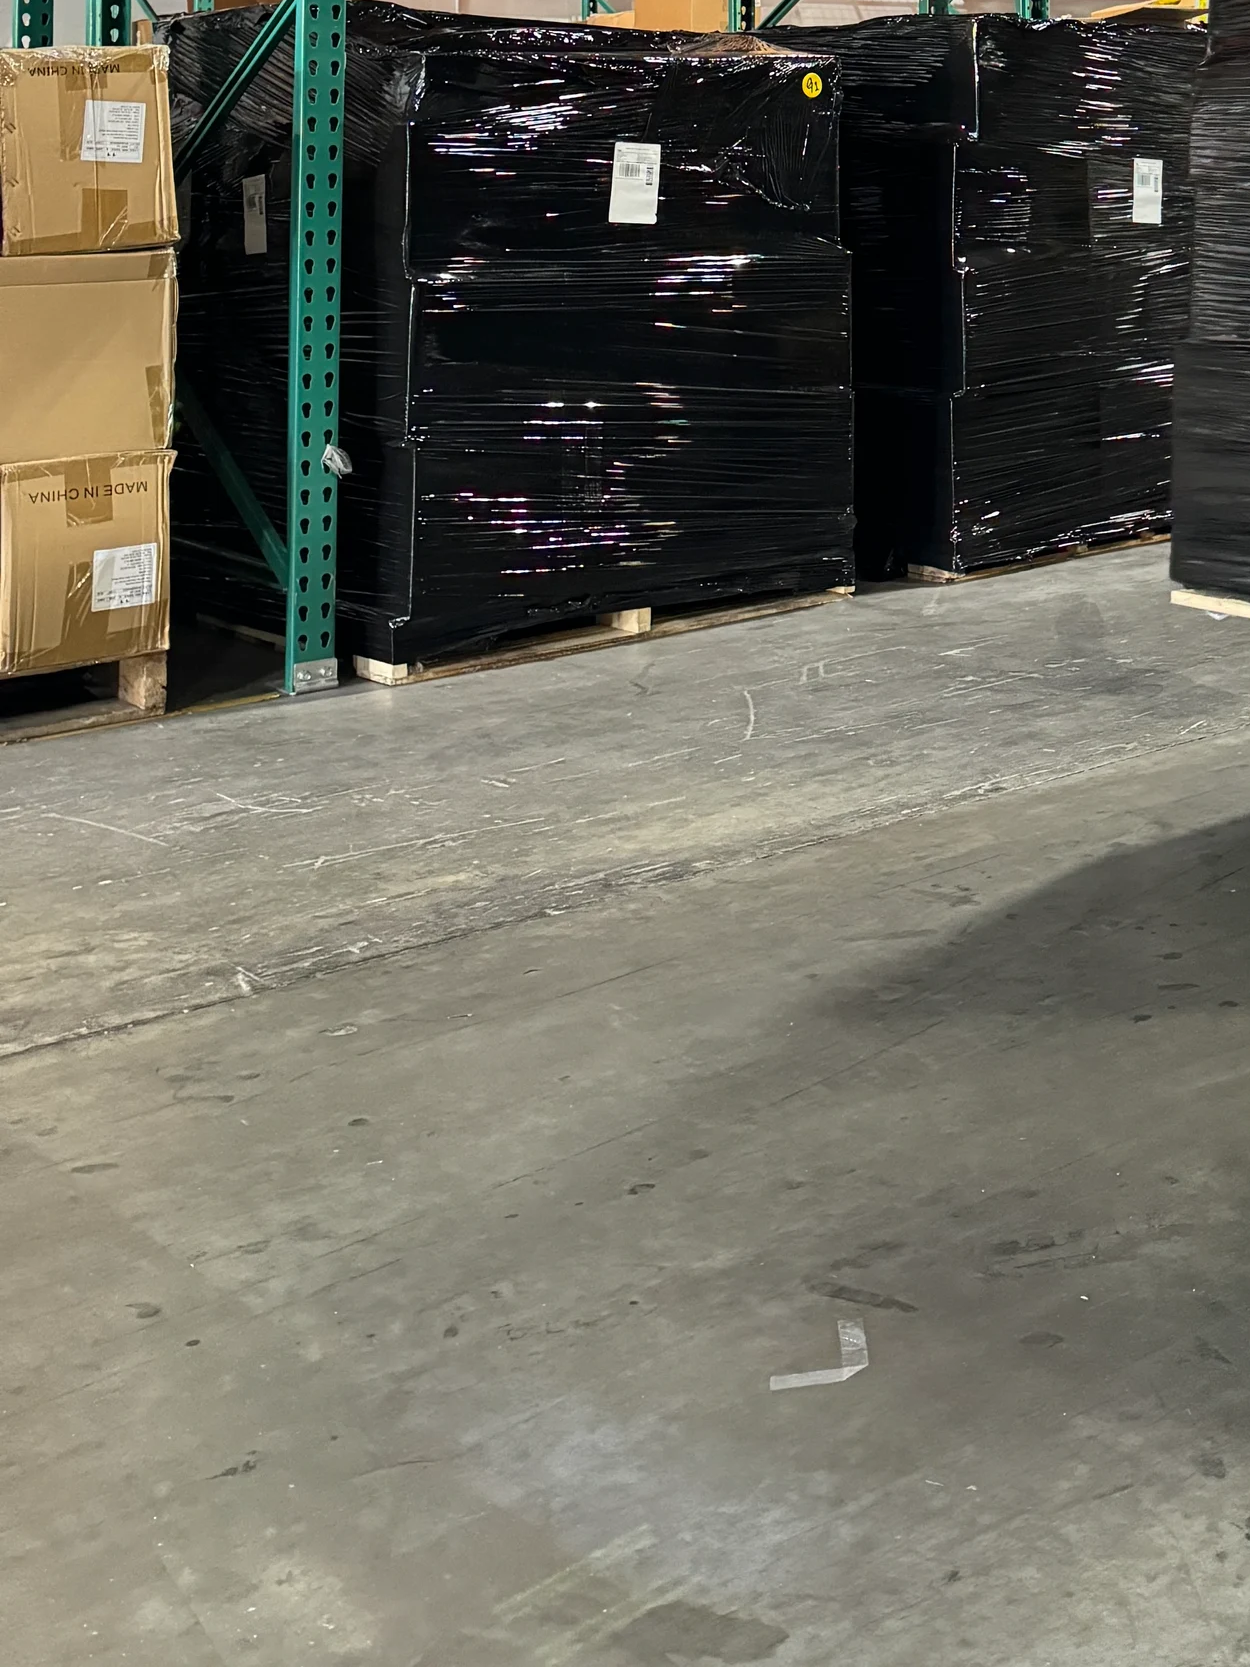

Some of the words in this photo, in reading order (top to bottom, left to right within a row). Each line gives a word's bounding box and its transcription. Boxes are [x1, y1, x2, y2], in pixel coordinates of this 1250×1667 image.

[28, 65, 68, 77] CHINA
[28, 488, 79, 504] CHINA
[84, 487, 99, 498] IN
[103, 481, 148, 497] MADE
